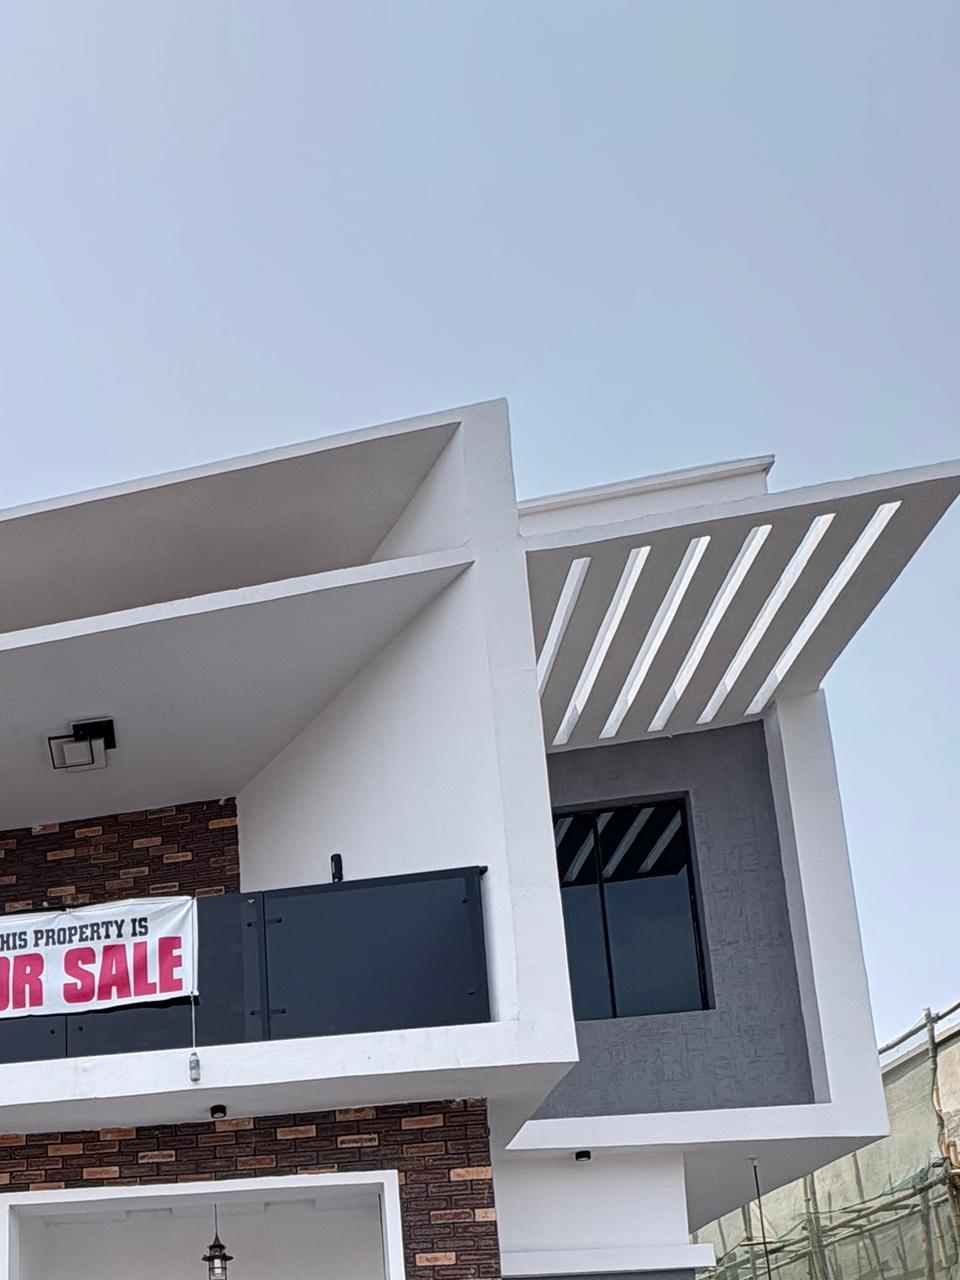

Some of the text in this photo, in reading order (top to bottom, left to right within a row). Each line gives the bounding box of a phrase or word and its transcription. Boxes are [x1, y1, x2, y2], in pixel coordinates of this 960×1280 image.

[33, 918, 126, 948] PROPERTY
[131, 917, 149, 937] IS
[63, 936, 183, 1004] SALE
